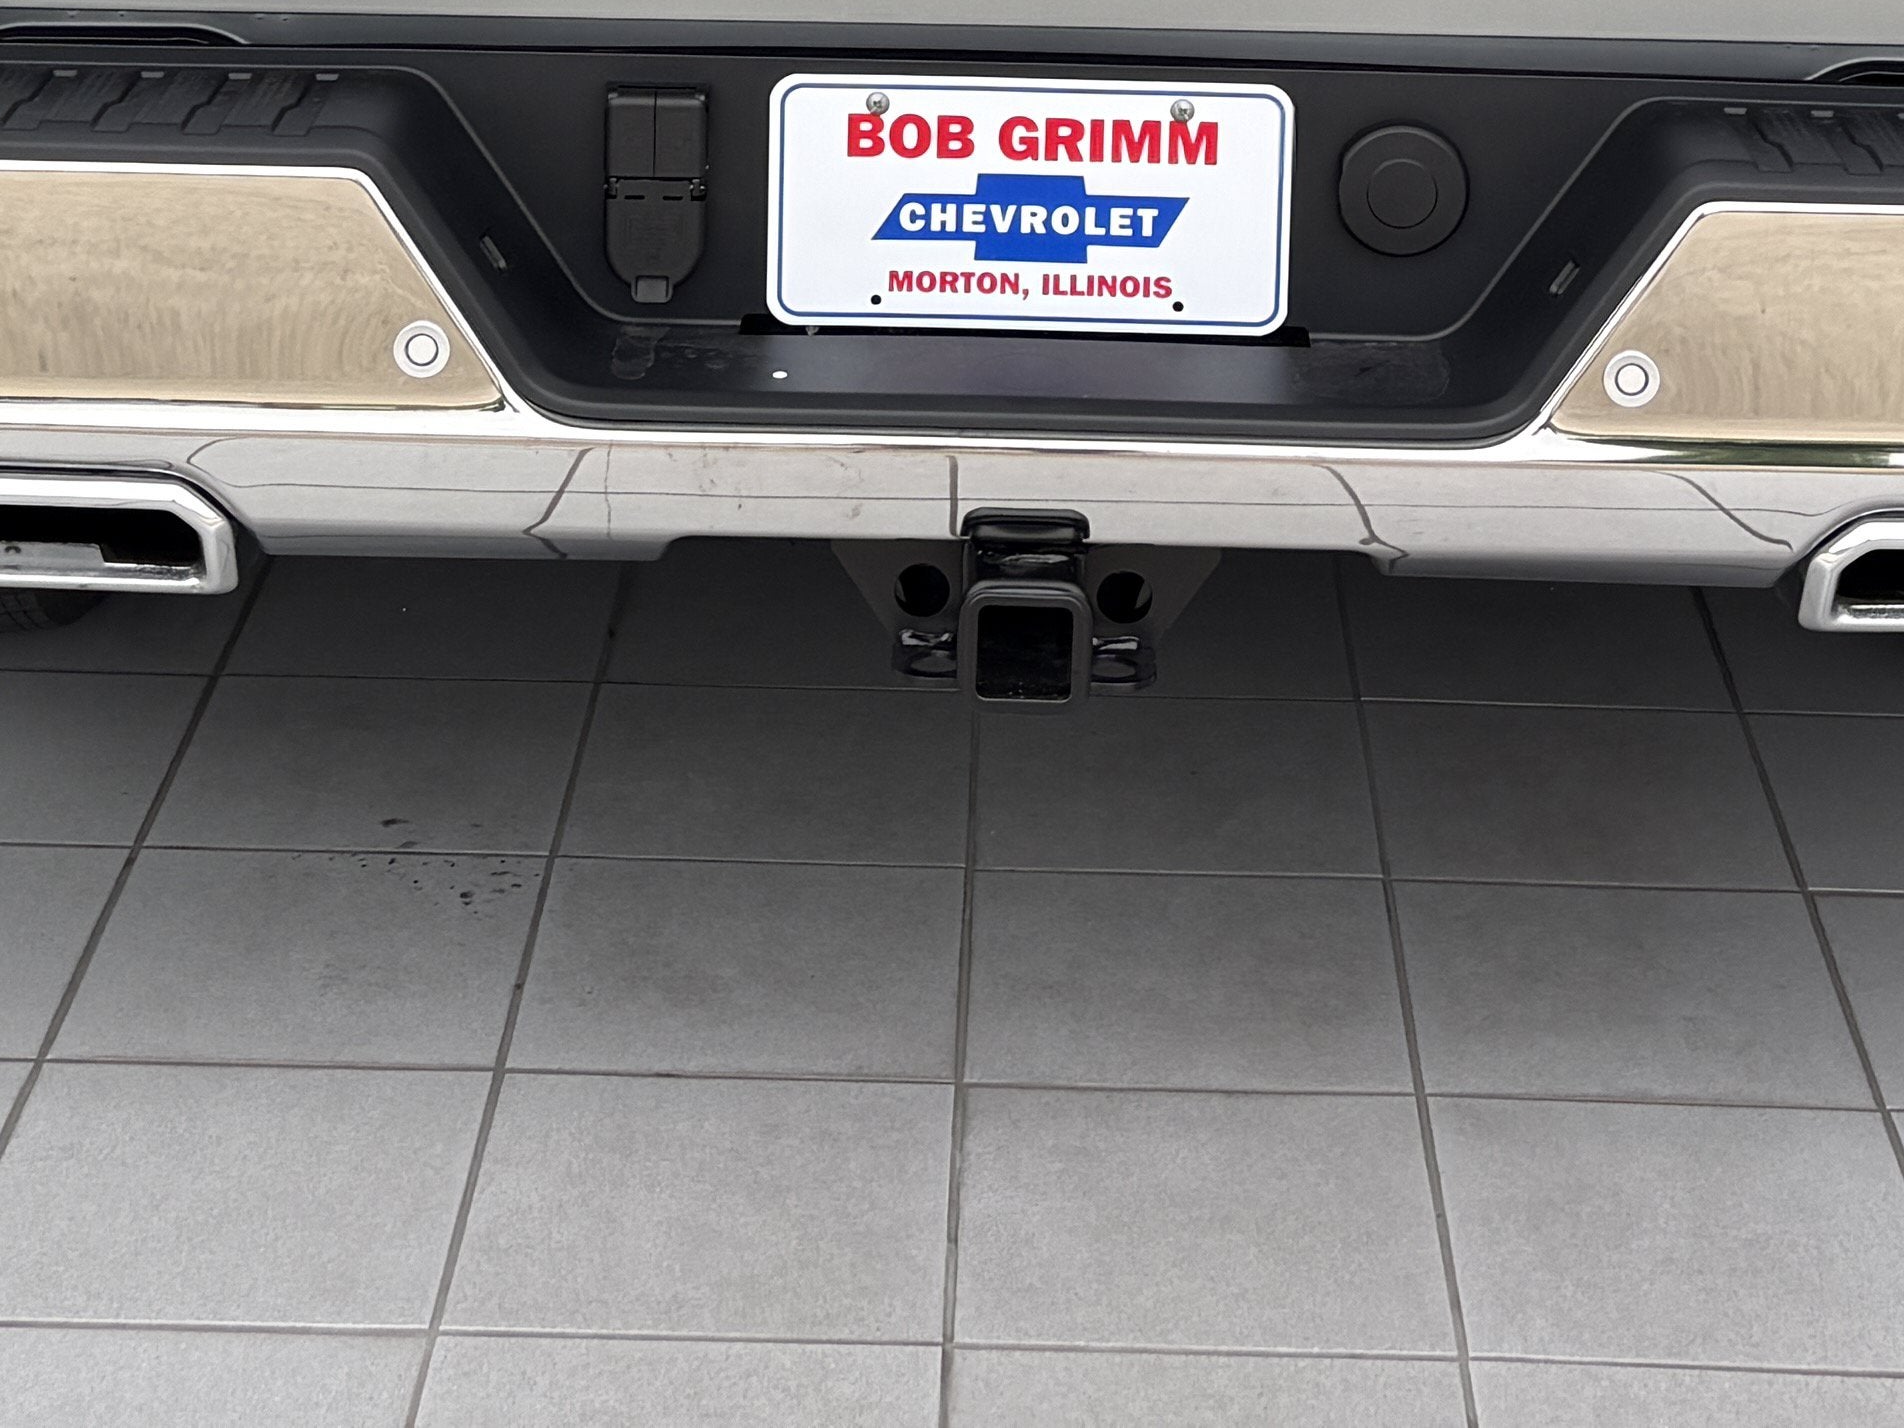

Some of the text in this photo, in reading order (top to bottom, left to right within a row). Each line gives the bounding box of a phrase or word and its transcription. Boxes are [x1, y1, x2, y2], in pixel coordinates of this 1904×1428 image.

[846, 113, 1219, 166] BOB GRIMM
[898, 201, 1160, 238] CHEVROLET
[887, 270, 1173, 301] MORTON, ILLINOIS
